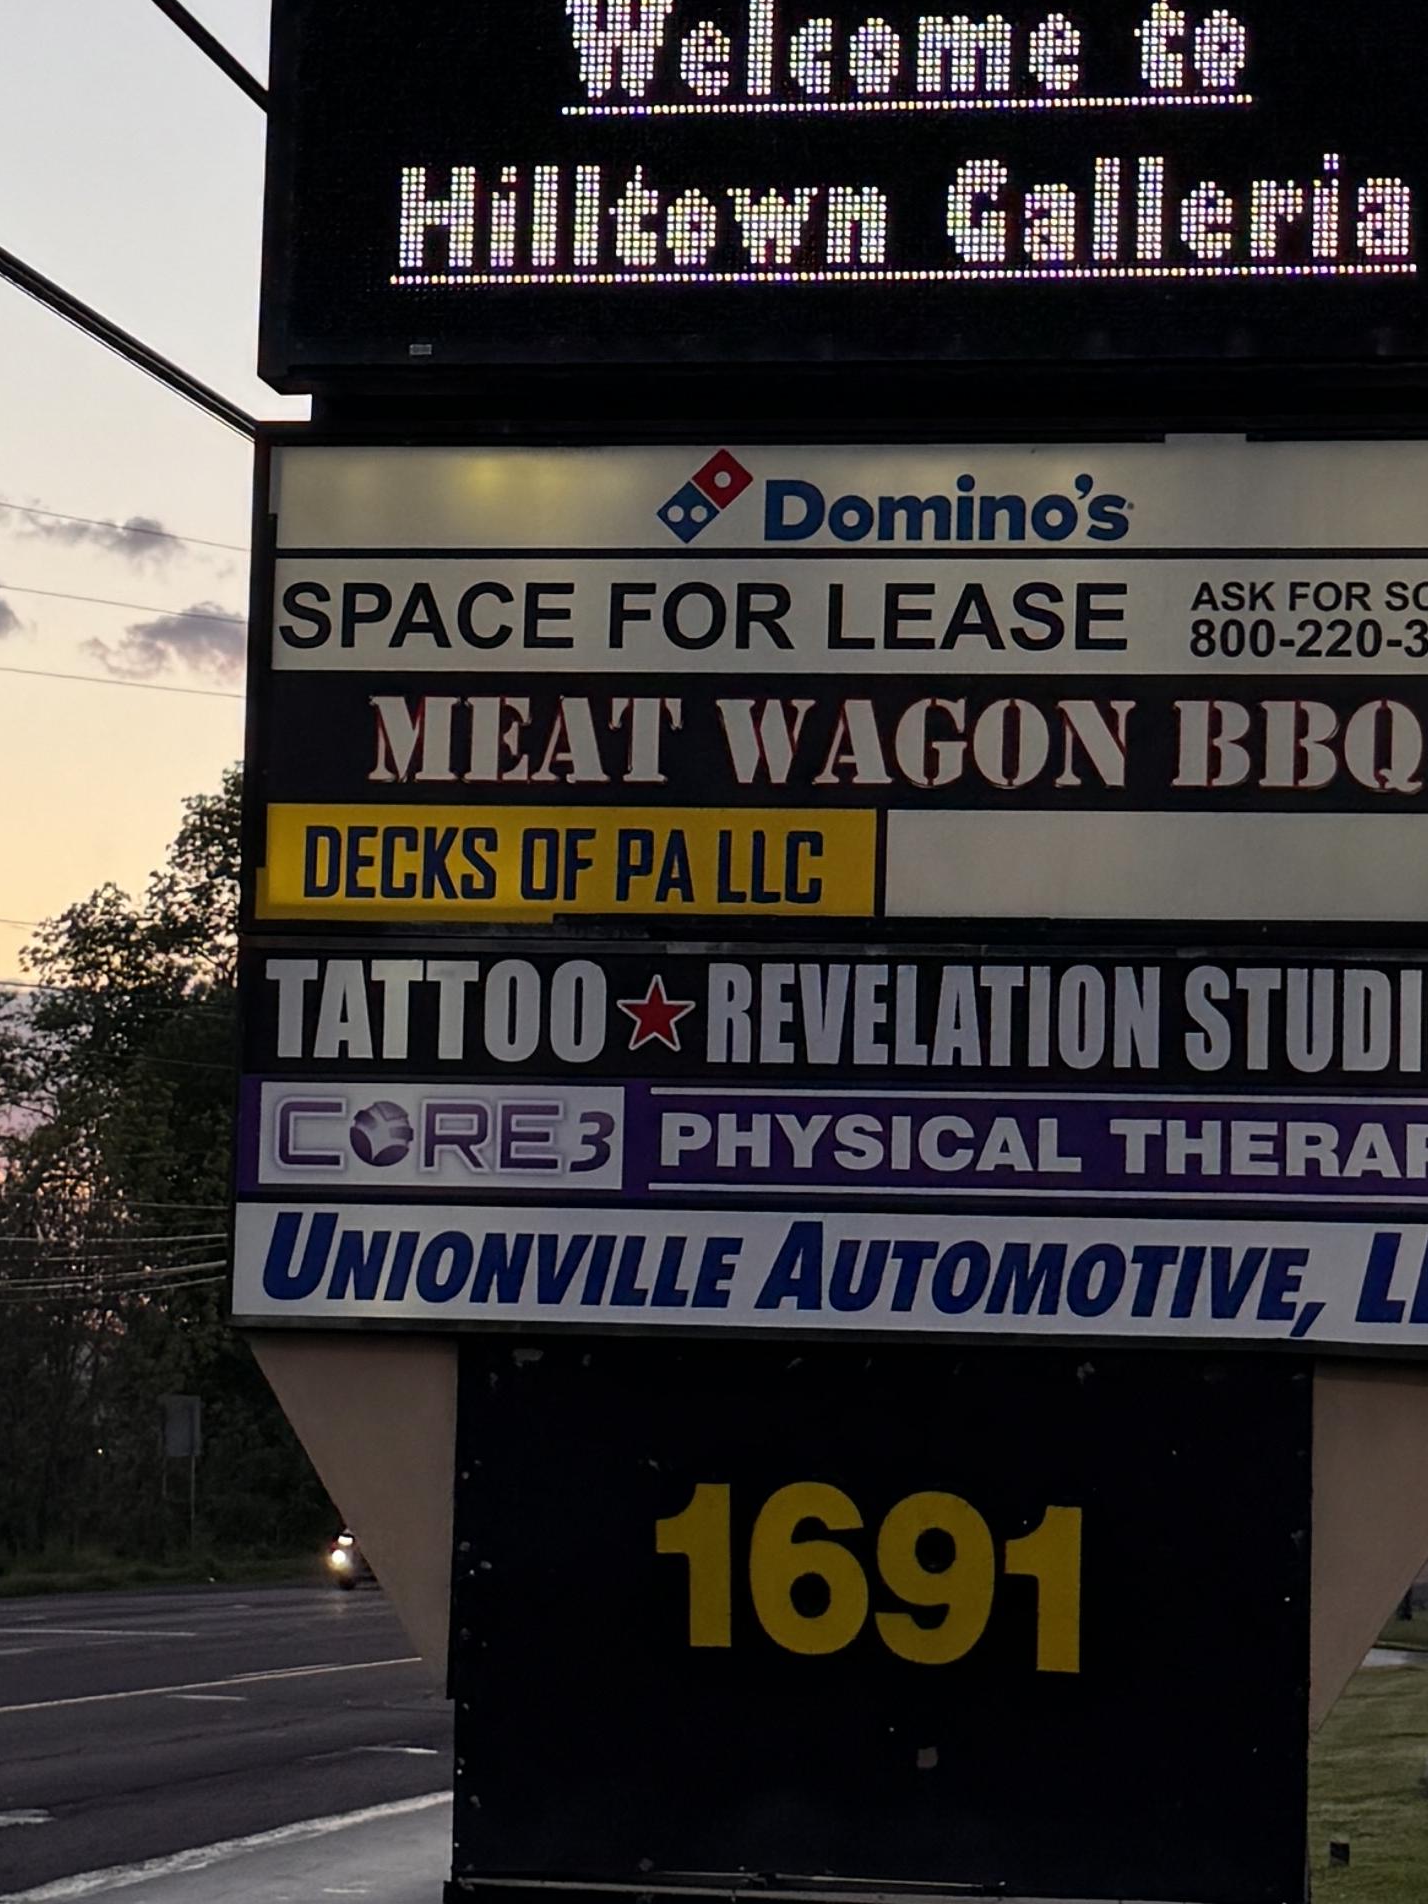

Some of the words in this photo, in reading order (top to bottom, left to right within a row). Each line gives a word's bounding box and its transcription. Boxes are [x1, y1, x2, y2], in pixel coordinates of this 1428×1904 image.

[399, 165, 888, 268] Hilltown
[947, 156, 1417, 264] Galleria
[764, 472, 1129, 542] Domino's
[278, 581, 575, 653] SPACE
[608, 581, 795, 653] FOR
[826, 581, 1129, 654] LEASE
[1190, 582, 1275, 612] ASK
[1286, 582, 1375, 612] FOR
[370, 696, 684, 787] MEAT
[717, 698, 1138, 790] WAGON
[1171, 699, 1425, 794] BBQ
[303, 826, 493, 902] DECKS
[519, 826, 595, 902] OF
[615, 828, 693, 904] PA
[717, 830, 824, 906] LLC
[266, 957, 608, 1066] TATTOO
[707, 962, 1160, 1071] REVELATION
[660, 1112, 1083, 1172] PHYSICAL
[260, 1211, 742, 1303] UNIONVILLE
[756, 1220, 1338, 1338] AUTOMOTIVE,
[655, 1481, 1082, 1674] 1691
